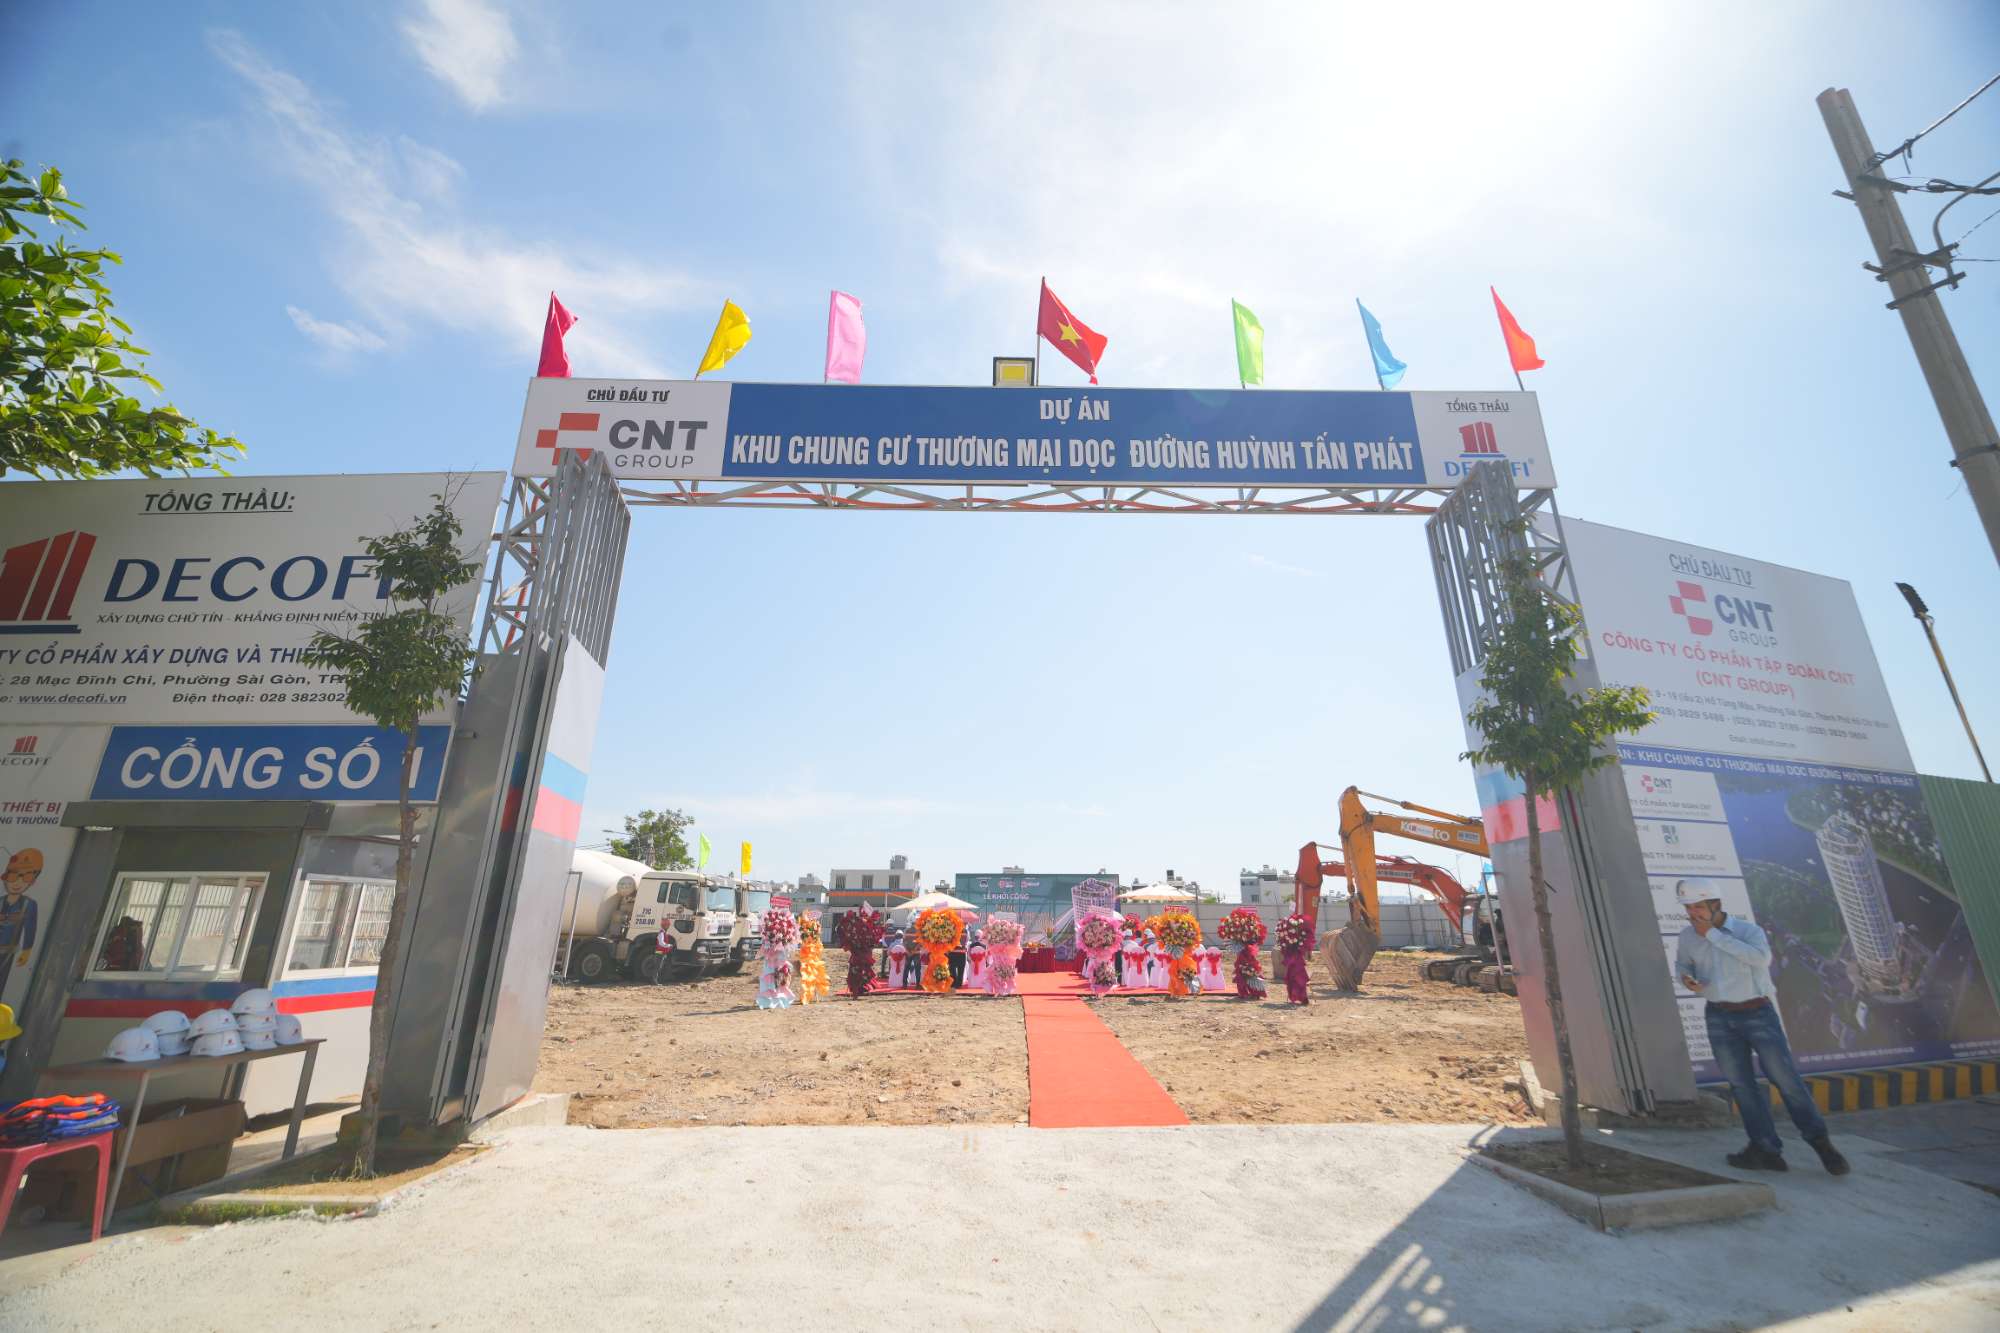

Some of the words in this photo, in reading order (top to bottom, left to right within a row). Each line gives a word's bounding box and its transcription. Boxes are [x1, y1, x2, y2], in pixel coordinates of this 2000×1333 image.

[587, 387, 615, 401] CHỦ
[619, 388, 649, 402] ĐẦU
[652, 389, 670, 402] TƯ
[1446, 398, 1477, 411] TỔNG
[1479, 399, 1510, 411] THẦU
[1040, 397, 1072, 425] DỰ
[1077, 394, 1110, 421] ÁN
[608, 419, 708, 450] CNT
[615, 454, 694, 468] GROUP
[731, 434, 780, 464] KHU
[788, 436, 868, 465] CHUNG
[877, 435, 912, 466] CƯ
[917, 435, 1009, 466] THƯƠNG
[1017, 439, 1061, 472] MẠI
[1069, 439, 1115, 473] DỌC
[1129, 433, 1209, 469] ĐƯỜNG
[1217, 435, 1296, 469] HUỲNH
[1301, 432, 1349, 470] TẤN
[1355, 435, 1414, 471] PHÁT
[1444, 461, 1530, 477] DEFI
[145, 489, 212, 511] TỔNG
[222, 488, 295, 510] THẦU:
[103, 556, 394, 602] DECOFI
[1669, 553, 1699, 574] CHỦ
[1733, 567, 1753, 586] TƯ
[96, 610, 123, 624] XÂY
[125, 612, 164, 625] DỰNG
[202, 610, 223, 623] TÍN
[285, 612, 320, 623] ĐỊNH
[323, 609, 358, 622] NIỀM
[362, 612, 386, 622] TIN
[1714, 594, 1774, 632] CNT
[1729, 629, 1778, 648] GROUP
[25, 641, 58, 664] CỔ
[60, 642, 117, 664] PHẦN
[122, 644, 166, 663] XÂY
[169, 645, 229, 667] DỰNG
[236, 644, 261, 663] VÀ
[1602, 631, 1653, 652] CÔNG
[1656, 641, 1677, 656] TY
[1682, 641, 1706, 660] CỔ
[1709, 648, 1751, 668] PHẦN
[1754, 656, 1782, 674] TẬP
[1785, 662, 1825, 681] ĐOÀN
[1829, 670, 1855, 685] CNT
[10, 675, 30, 685] 28
[36, 675, 70, 687] Mạc
[76, 674, 118, 685] Đĩnh
[163, 674, 231, 687] Phường
[236, 674, 264, 685] Sài
[270, 674, 311, 686] Gòn,
[1696, 670, 1732, 688] (CNT
[1736, 676, 1795, 701] GROUP)
[18, 693, 127, 704] www.decofi.vn
[172, 692, 206, 704] Điện
[212, 692, 254, 704] thoại:
[260, 692, 286, 702] 028
[121, 736, 283, 790] CỔNG
[300, 736, 381, 790] SỐ
[1638, 749, 1662, 764] KHU
[1664, 752, 1703, 767] CHUNG
[1705, 756, 1721, 769] CƯ
[1724, 759, 1766, 773] THƯƠNG
[1, 798, 44, 812] THIẾT
[47, 802, 61, 814] BỊ
[16, 815, 59, 825] TRƯỜNG
